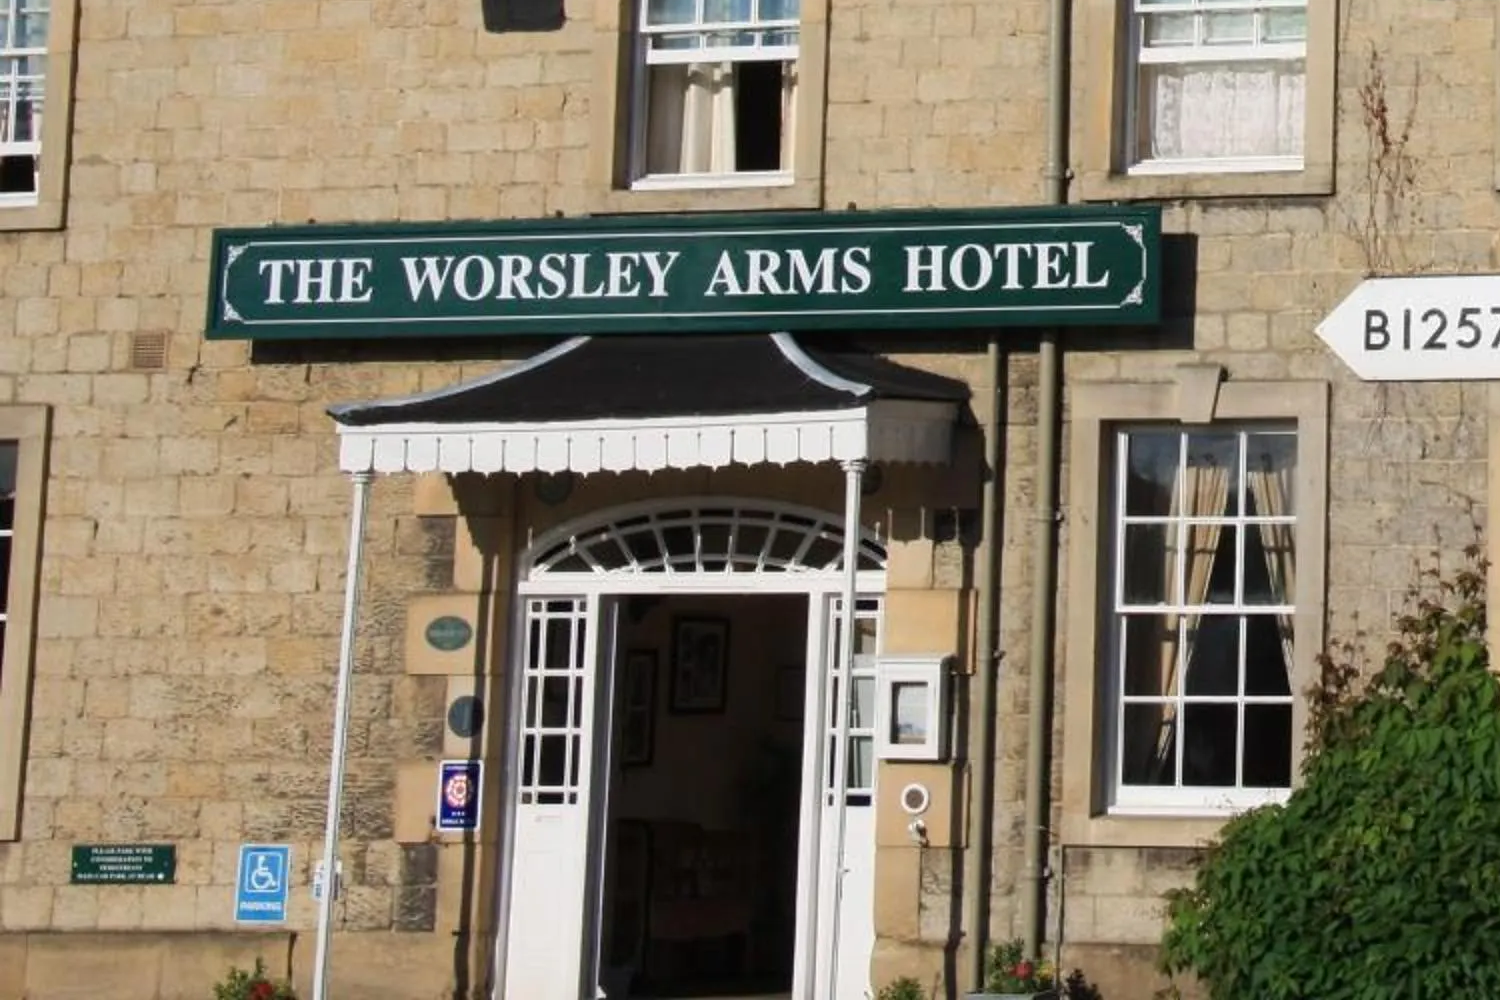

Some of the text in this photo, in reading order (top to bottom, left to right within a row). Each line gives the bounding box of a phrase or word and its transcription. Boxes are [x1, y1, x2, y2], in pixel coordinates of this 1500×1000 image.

[259, 241, 1110, 304] THE WORSLEY ARMS HOTEL
